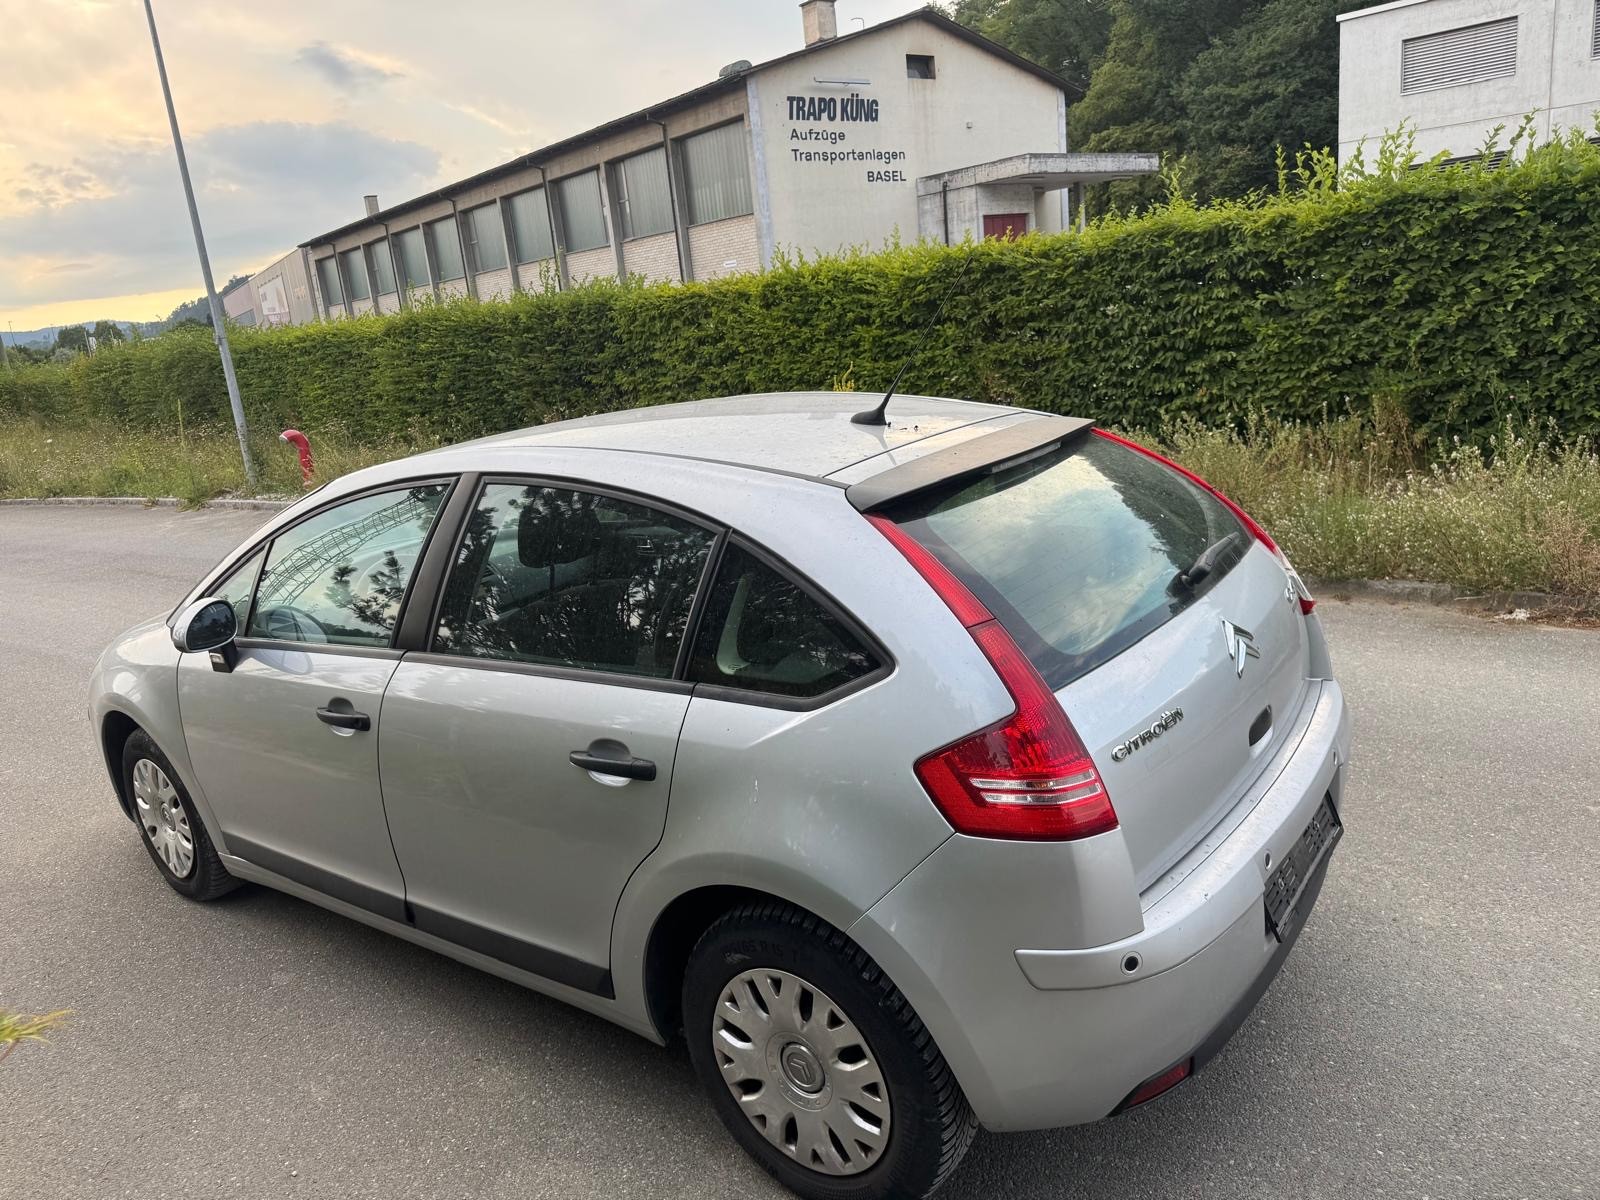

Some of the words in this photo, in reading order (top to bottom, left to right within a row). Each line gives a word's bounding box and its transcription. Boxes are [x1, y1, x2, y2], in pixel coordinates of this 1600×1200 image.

[786, 96, 837, 122] TRAPO
[840, 93, 879, 122] KÜNG
[790, 128, 846, 145] Aufzüge
[791, 149, 906, 165] Transportanlagen
[867, 170, 907, 182] BASEL
[1111, 707, 1184, 762] CITROËN
